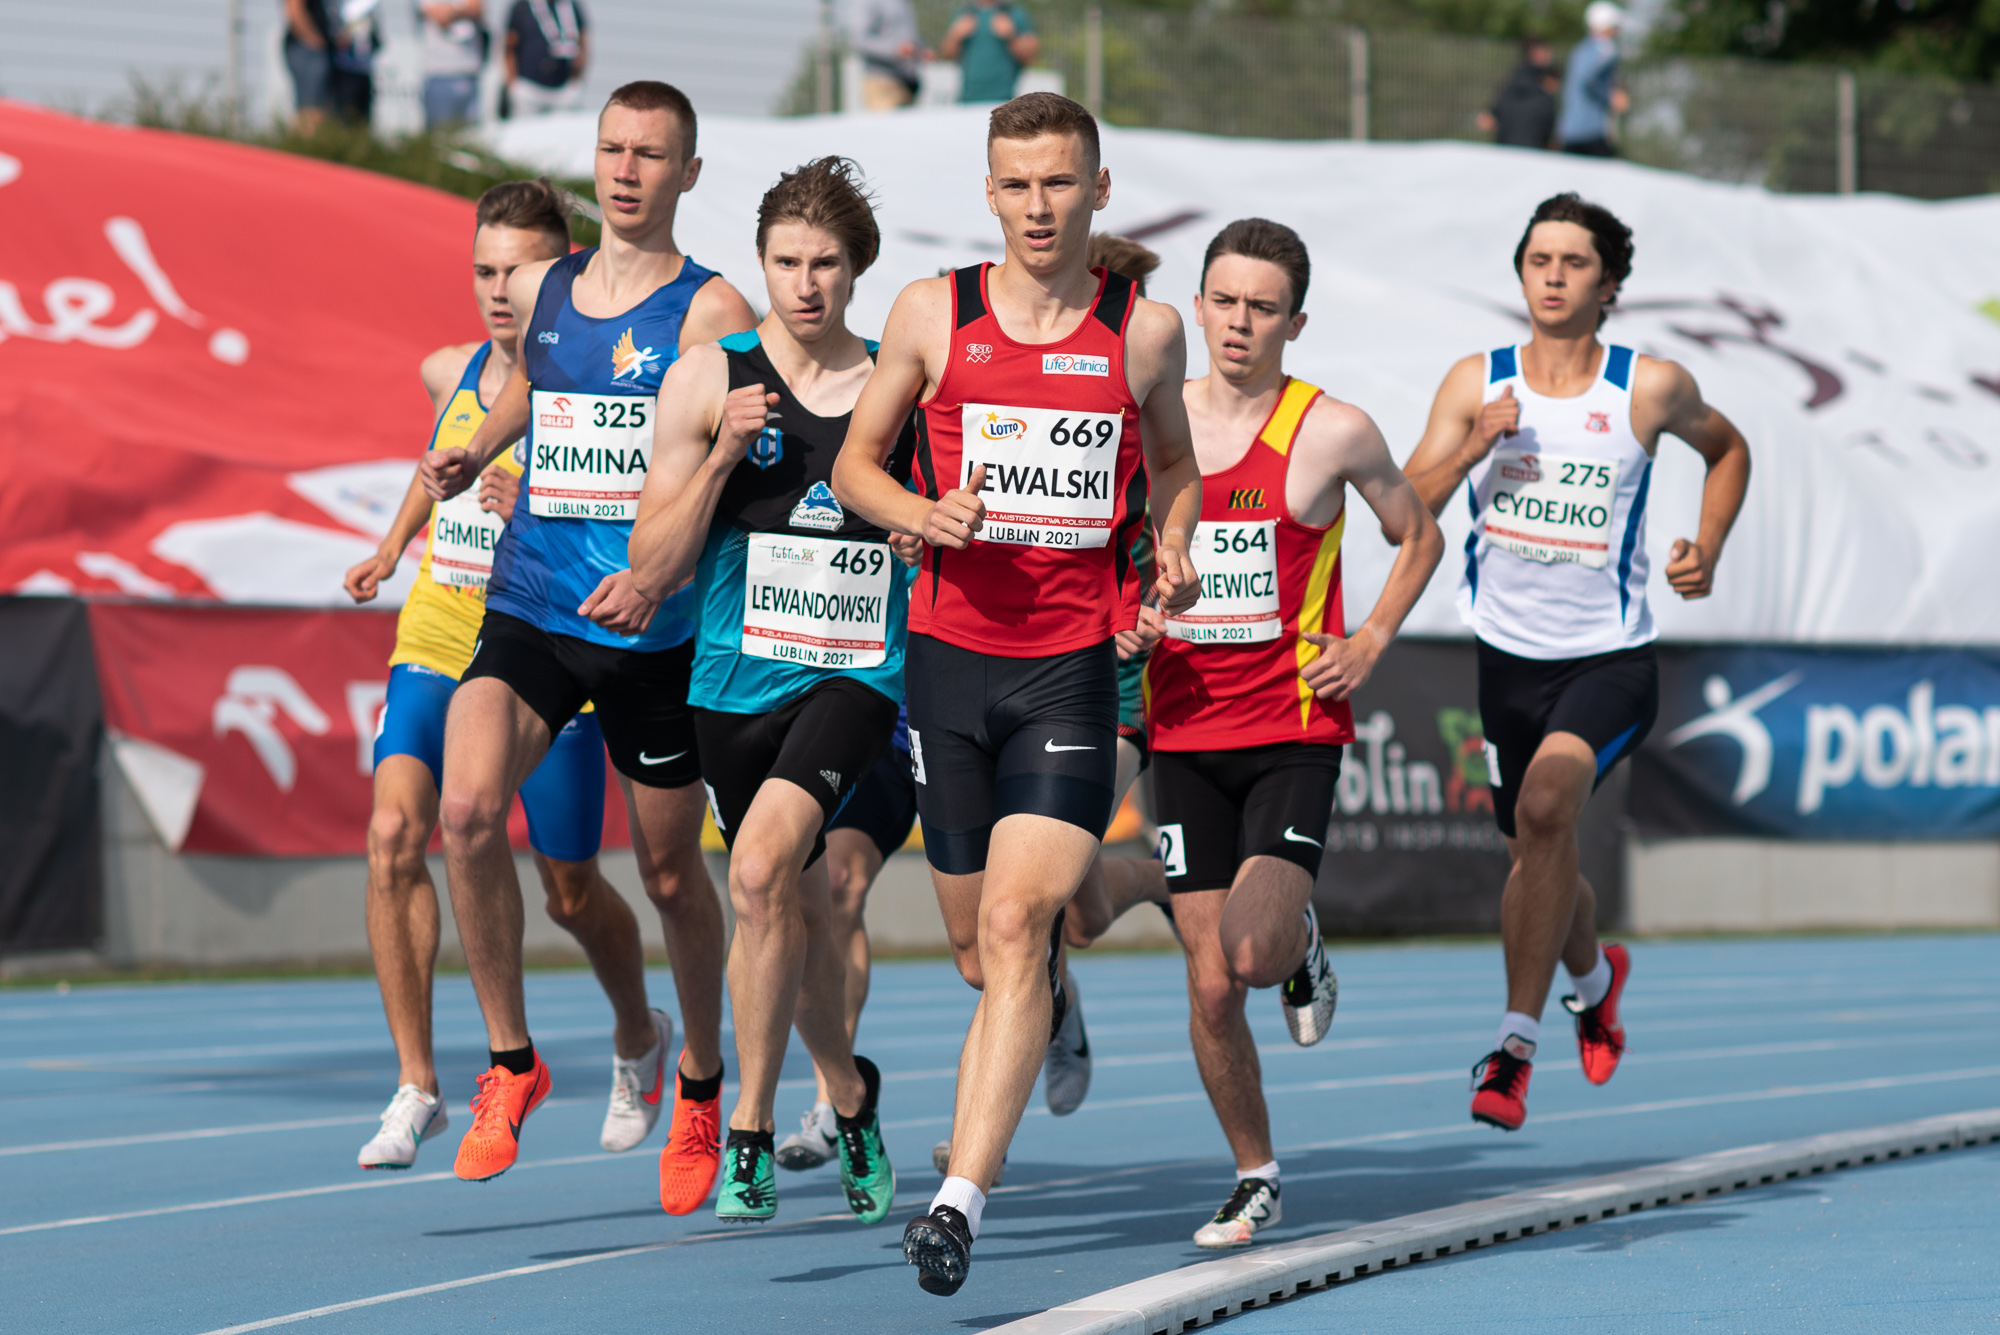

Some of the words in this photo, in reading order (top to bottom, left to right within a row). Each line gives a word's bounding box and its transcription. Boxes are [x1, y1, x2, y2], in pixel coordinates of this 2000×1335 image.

[538, 331, 560, 345] esa
[541, 415, 572, 427] ORLEN
[593, 402, 646, 428] 325
[990, 423, 1018, 436] LOTTO
[1050, 417, 1114, 448] 669
[536, 444, 648, 474] SKIMINA
[1559, 462, 1610, 488] 275
[548, 502, 589, 515] LUBLIN
[594, 504, 625, 516] 2021
[1493, 491, 1607, 528] CYDEJKO
[999, 513, 1061, 525] MISTRZOSTWA
[1062, 519, 1090, 527] POLSKI
[989, 526, 1040, 543] LUBLIN
[1045, 531, 1080, 546] 2021
[1213, 528, 1268, 554] 564
[829, 547, 884, 576] 469
[1509, 542, 1548, 559] LUBLIN
[1552, 550, 1580, 563] 2021
[752, 584, 882, 623] LEWANDOWSKI
[762, 628, 783, 639] PZLA
[783, 632, 837, 647] MISTRZOSTWA
[1181, 627, 1217, 640] LUBLIN
[1222, 627, 1252, 640] 2021
[773, 644, 818, 663] LUBLIN
[822, 652, 853, 665] 2021
[819, 769, 839, 796] adidas
